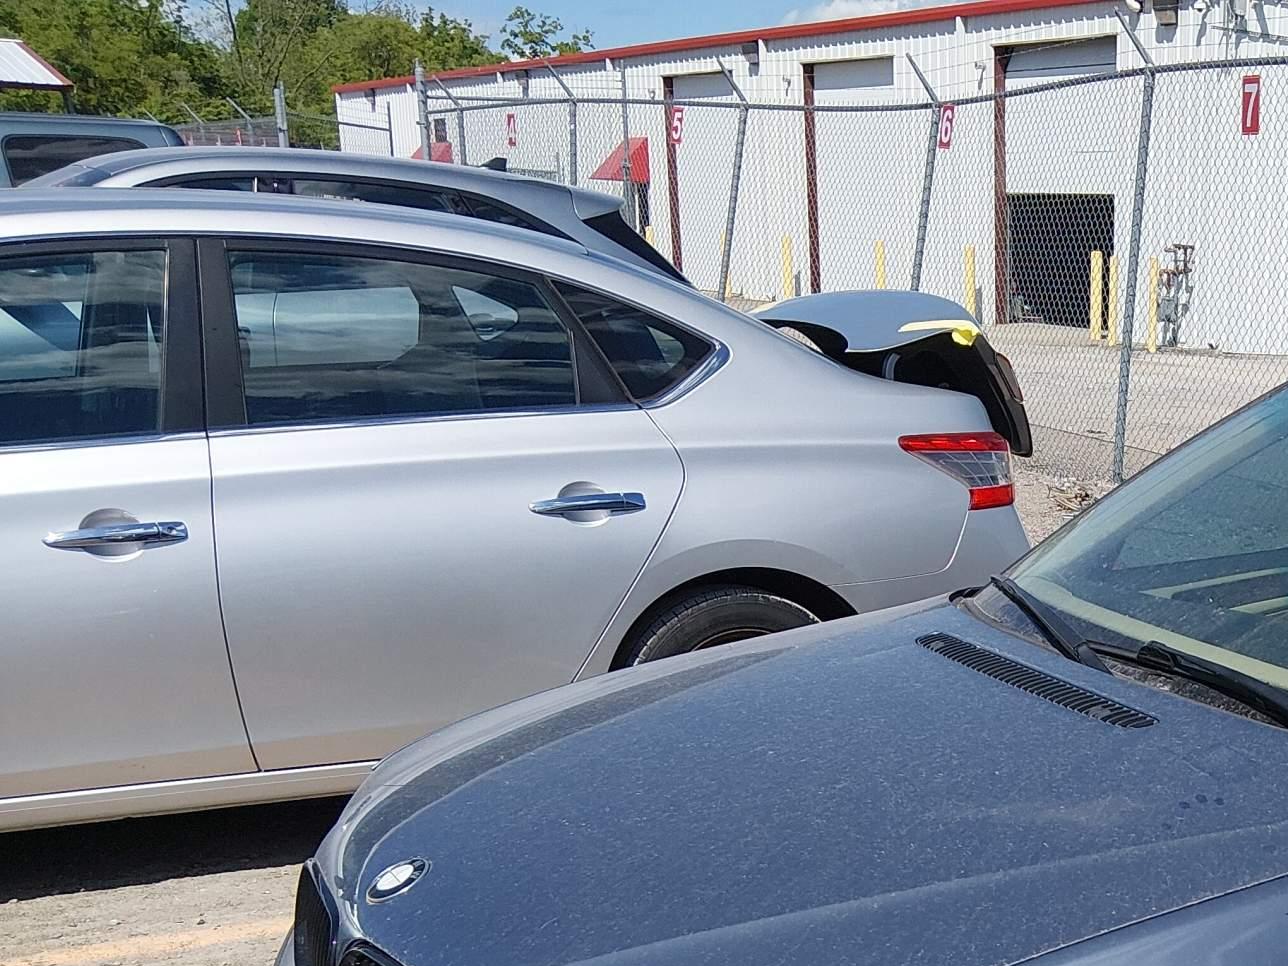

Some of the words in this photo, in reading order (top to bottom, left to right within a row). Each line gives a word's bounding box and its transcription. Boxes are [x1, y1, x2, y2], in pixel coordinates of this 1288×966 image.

[1244, 83, 1259, 127] 7
[672, 111, 683, 140] 5
[941, 109, 953, 143] 6
